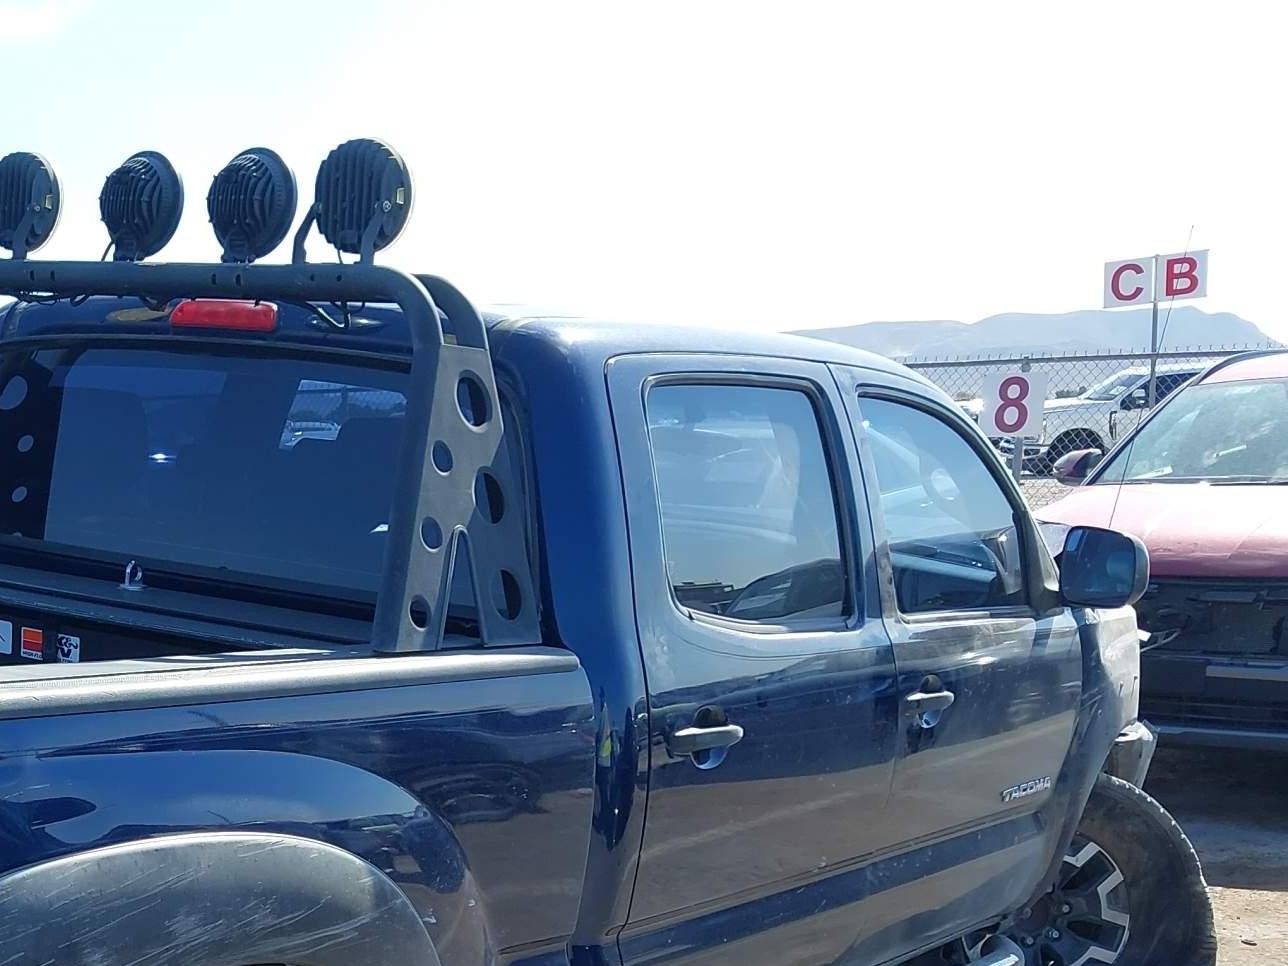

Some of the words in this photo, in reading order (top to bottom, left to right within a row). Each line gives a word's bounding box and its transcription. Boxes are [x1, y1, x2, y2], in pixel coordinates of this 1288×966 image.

[1112, 263, 1145, 301] C
[1165, 256, 1199, 297] B
[994, 376, 1029, 433] 8
[1001, 776, 1051, 802] TACOMA
